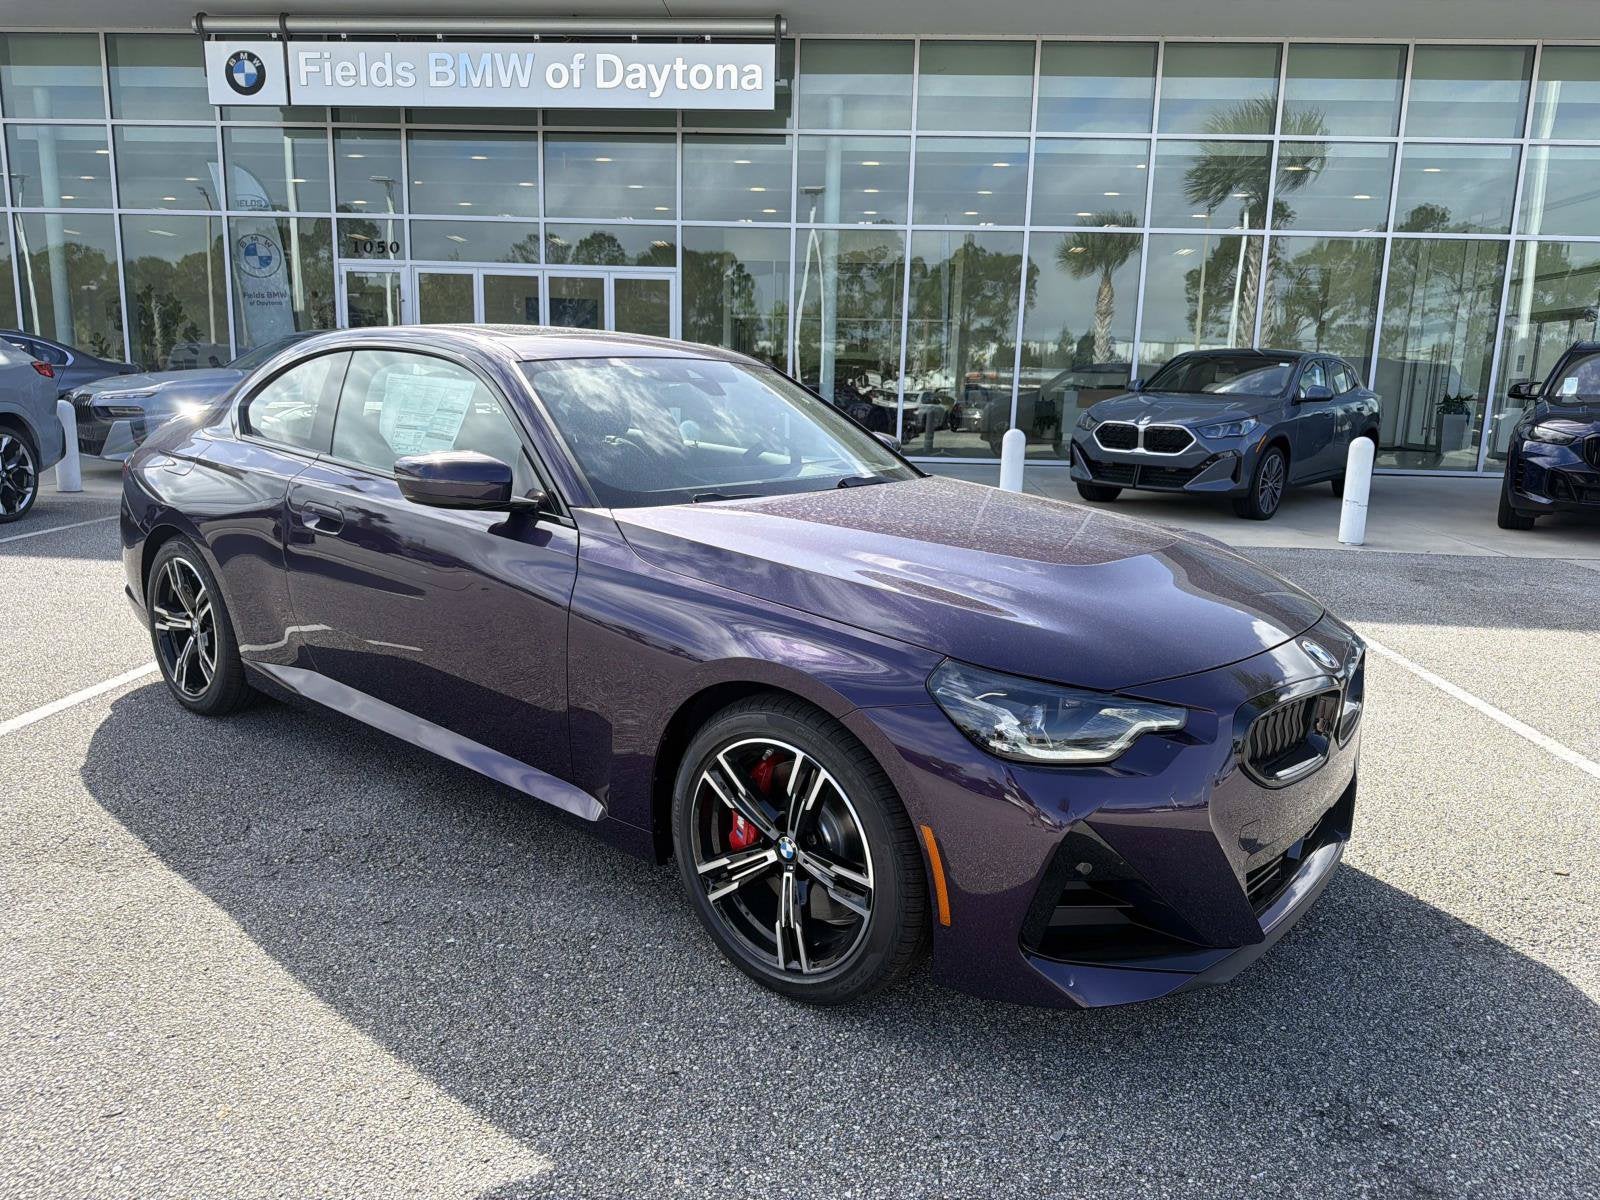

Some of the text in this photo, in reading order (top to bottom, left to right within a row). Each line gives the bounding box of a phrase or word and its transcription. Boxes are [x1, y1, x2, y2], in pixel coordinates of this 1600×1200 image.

[228, 52, 262, 67] BMW
[298, 51, 763, 98] Fields BMW of Daytona
[239, 236, 273, 249] BMW
[353, 240, 400, 254] 1050
[266, 290, 288, 299] BMW
